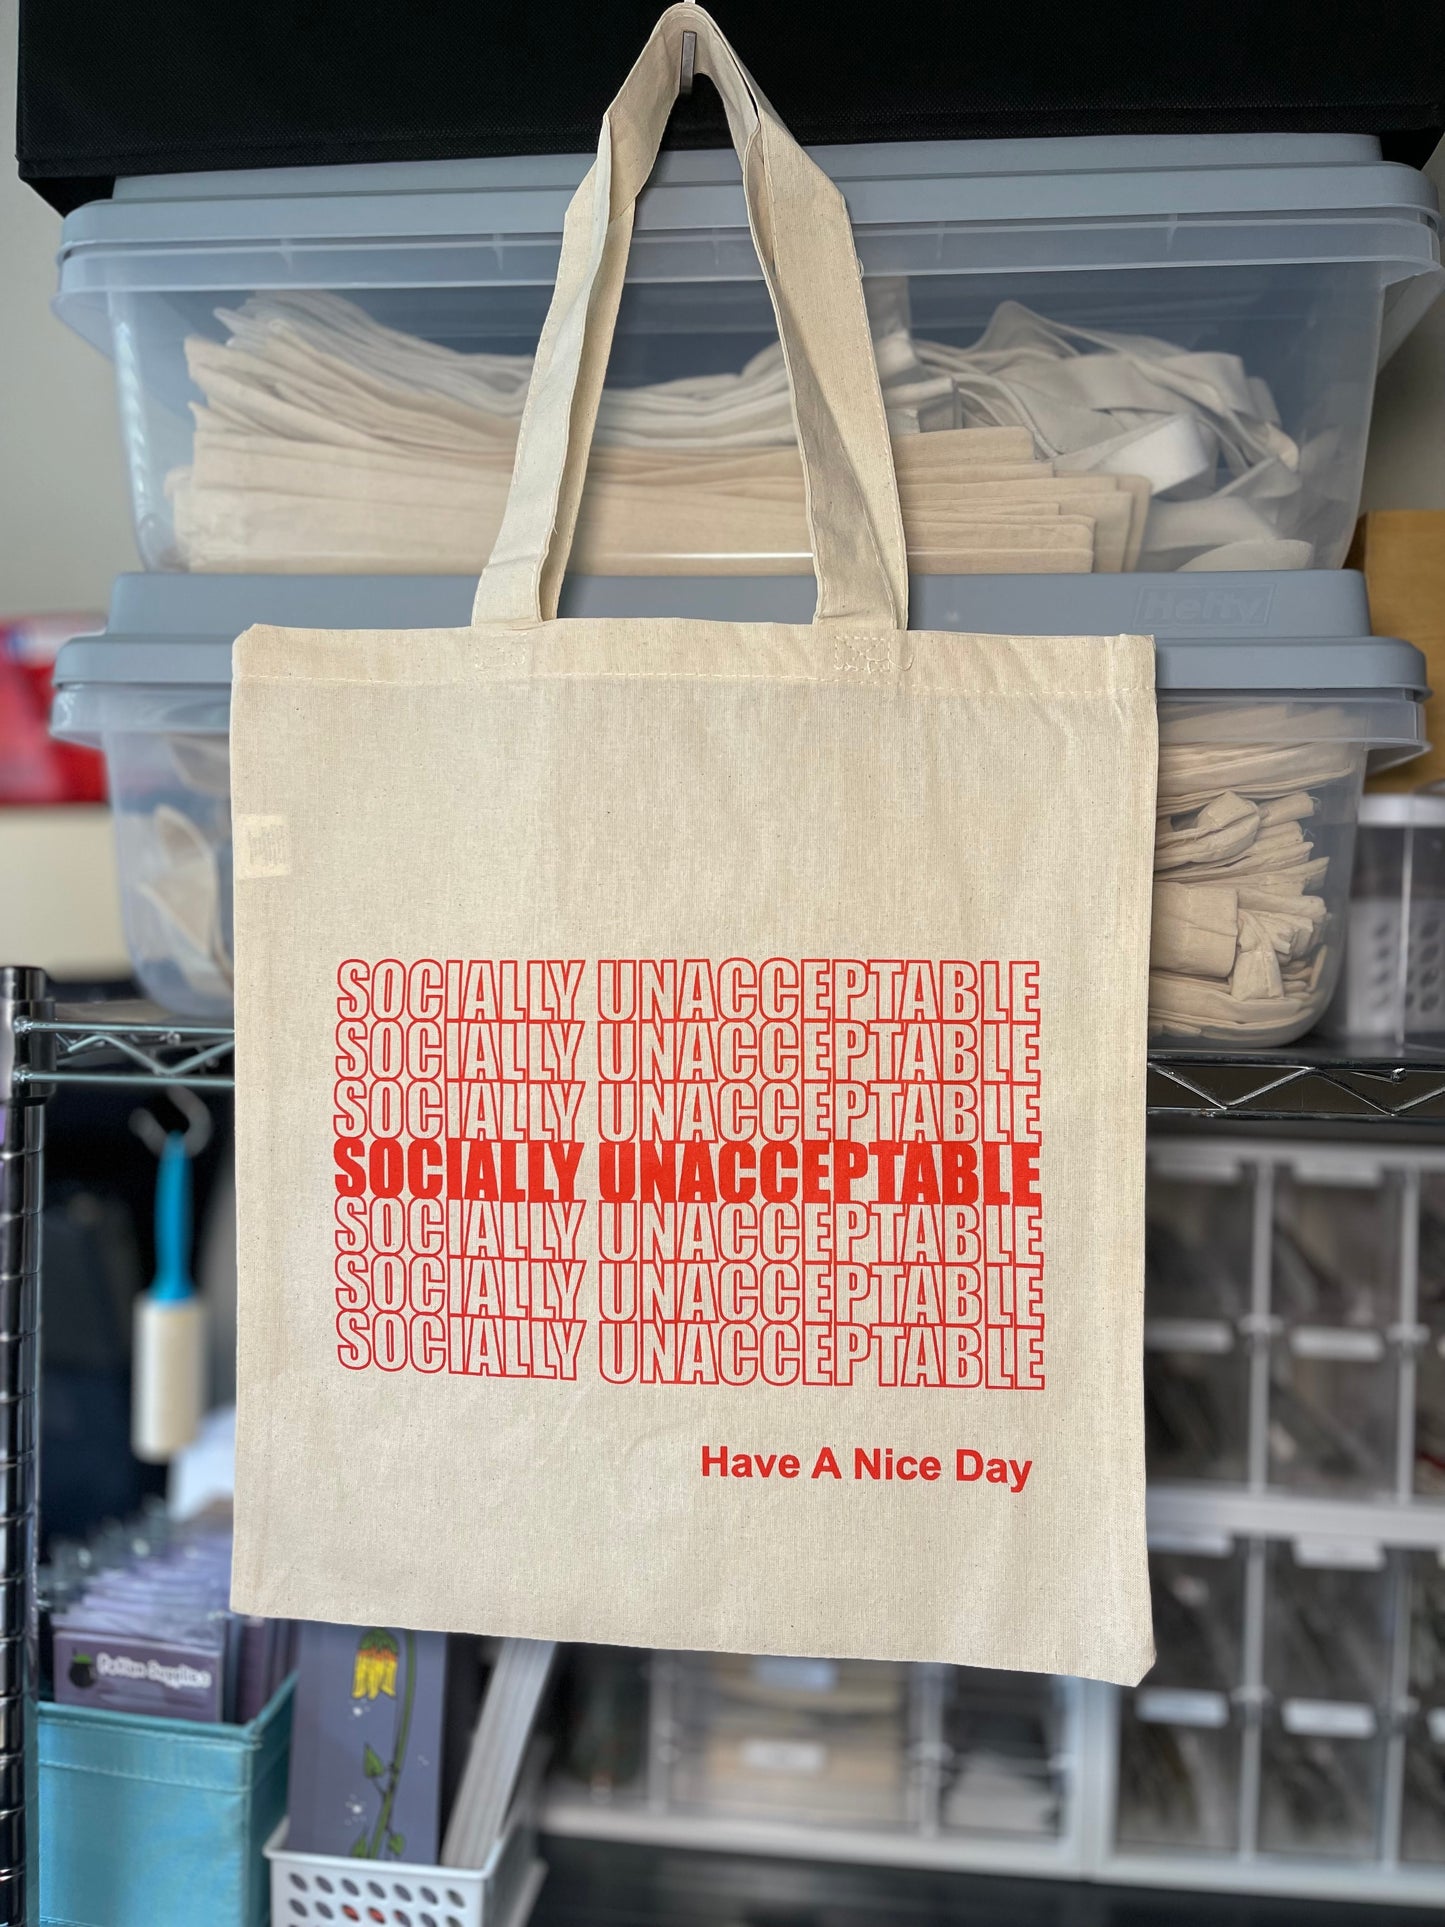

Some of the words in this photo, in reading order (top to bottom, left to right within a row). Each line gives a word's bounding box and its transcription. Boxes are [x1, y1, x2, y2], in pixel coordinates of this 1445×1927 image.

[1143, 590, 1267, 624] Hefty
[336, 958, 586, 1022] SOCIALLY
[597, 957, 1042, 1025] UNACCEPTABLE
[335, 1017, 585, 1083] SOCIALLY
[597, 1017, 1042, 1085] UNACCEPTABLE
[333, 1077, 586, 1143] SOCIALLY
[598, 1078, 1042, 1145] UNACCEPTABLE
[333, 1137, 585, 1203] SOCIALLY
[598, 1138, 1042, 1206] UNACCEPTABLE
[334, 1195, 587, 1261] SOCIALLY
[598, 1198, 1044, 1267] UNACCEPTABLE
[334, 1253, 587, 1320] SOCIALLY
[598, 1258, 1045, 1328] UNACCEPTABLE
[336, 1311, 587, 1381] SOCIALLY
[598, 1319, 1045, 1391] UNACCEPTABLE
[701, 1444, 800, 1479] Have
[811, 1446, 842, 1479] A
[853, 1446, 941, 1481] Nice
[955, 1447, 1032, 1493] Day
